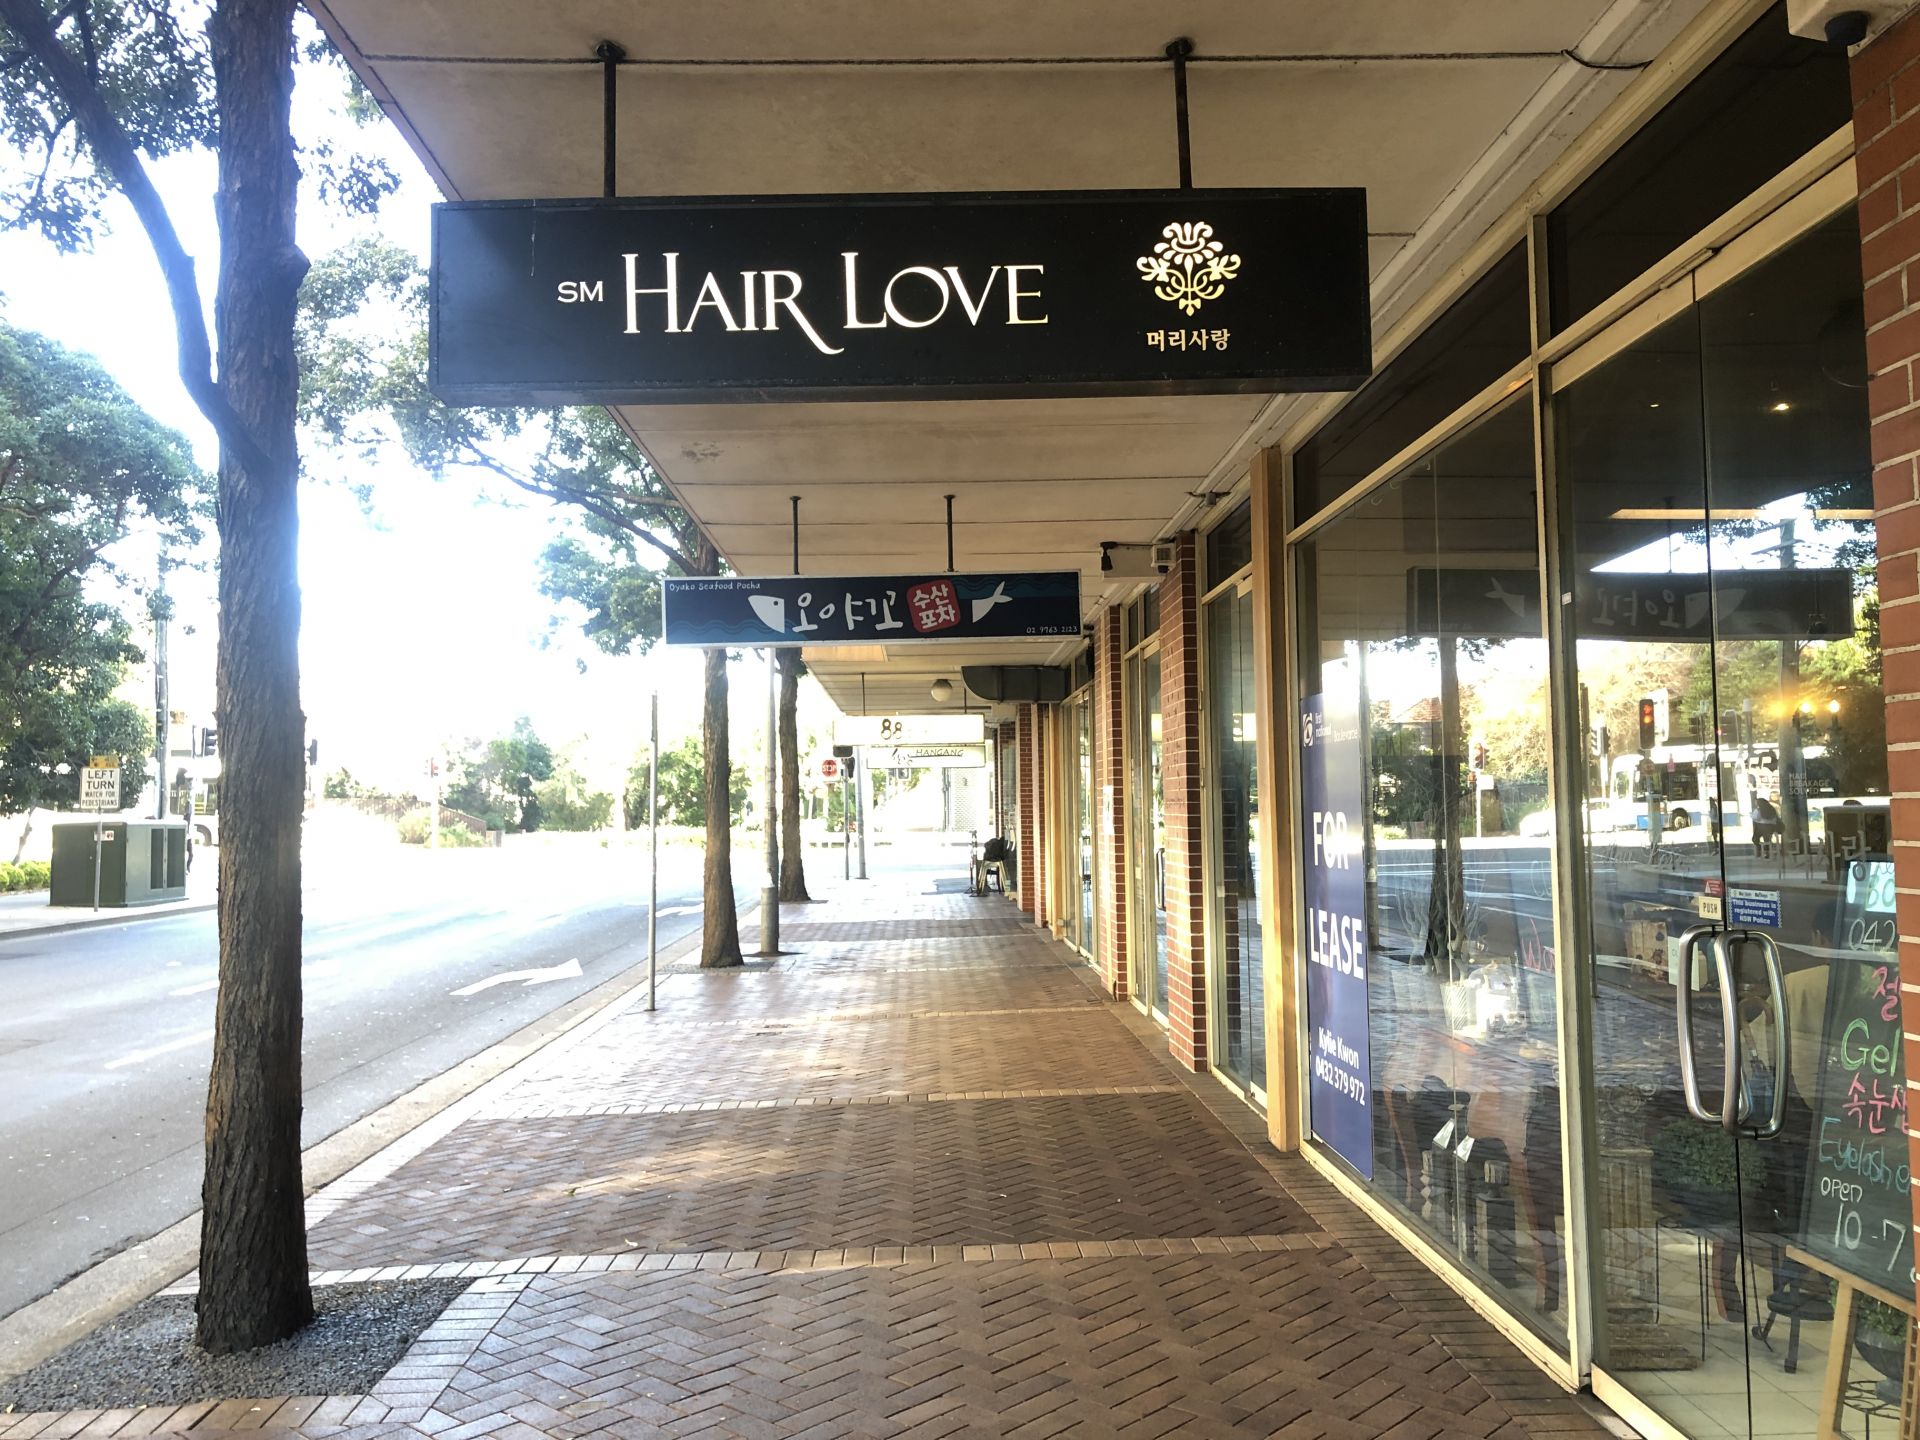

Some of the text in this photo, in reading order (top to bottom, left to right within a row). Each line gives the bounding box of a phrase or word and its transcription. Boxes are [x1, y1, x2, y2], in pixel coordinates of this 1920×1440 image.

[557, 252, 1049, 355] SM HAIR LOVE
[1146, 328, 1231, 352] 머리사랑
[669, 581, 761, 593] Oyako Seafood Pocha
[912, 584, 950, 609] 수산
[792, 590, 904, 633] 오야꼬
[919, 604, 956, 629] 포차
[1026, 625, 1078, 634] 02 9763 2123
[916, 748, 964, 758] HANGANG
[86, 780, 115, 790] TURN
[87, 769, 115, 779] LEFT
[82, 799, 118, 807] PEDESTRIANS
[85, 790, 116, 798] WATCH FOR
[1312, 811, 1349, 870] FOR
[1702, 902, 1718, 914] PUSH
[1309, 907, 1365, 981] LEASE
[1318, 1026, 1360, 1070] Kylie Kwon
[1840, 1017, 1901, 1078] Gel
[1315, 1055, 1366, 1106] 0432 379 972
